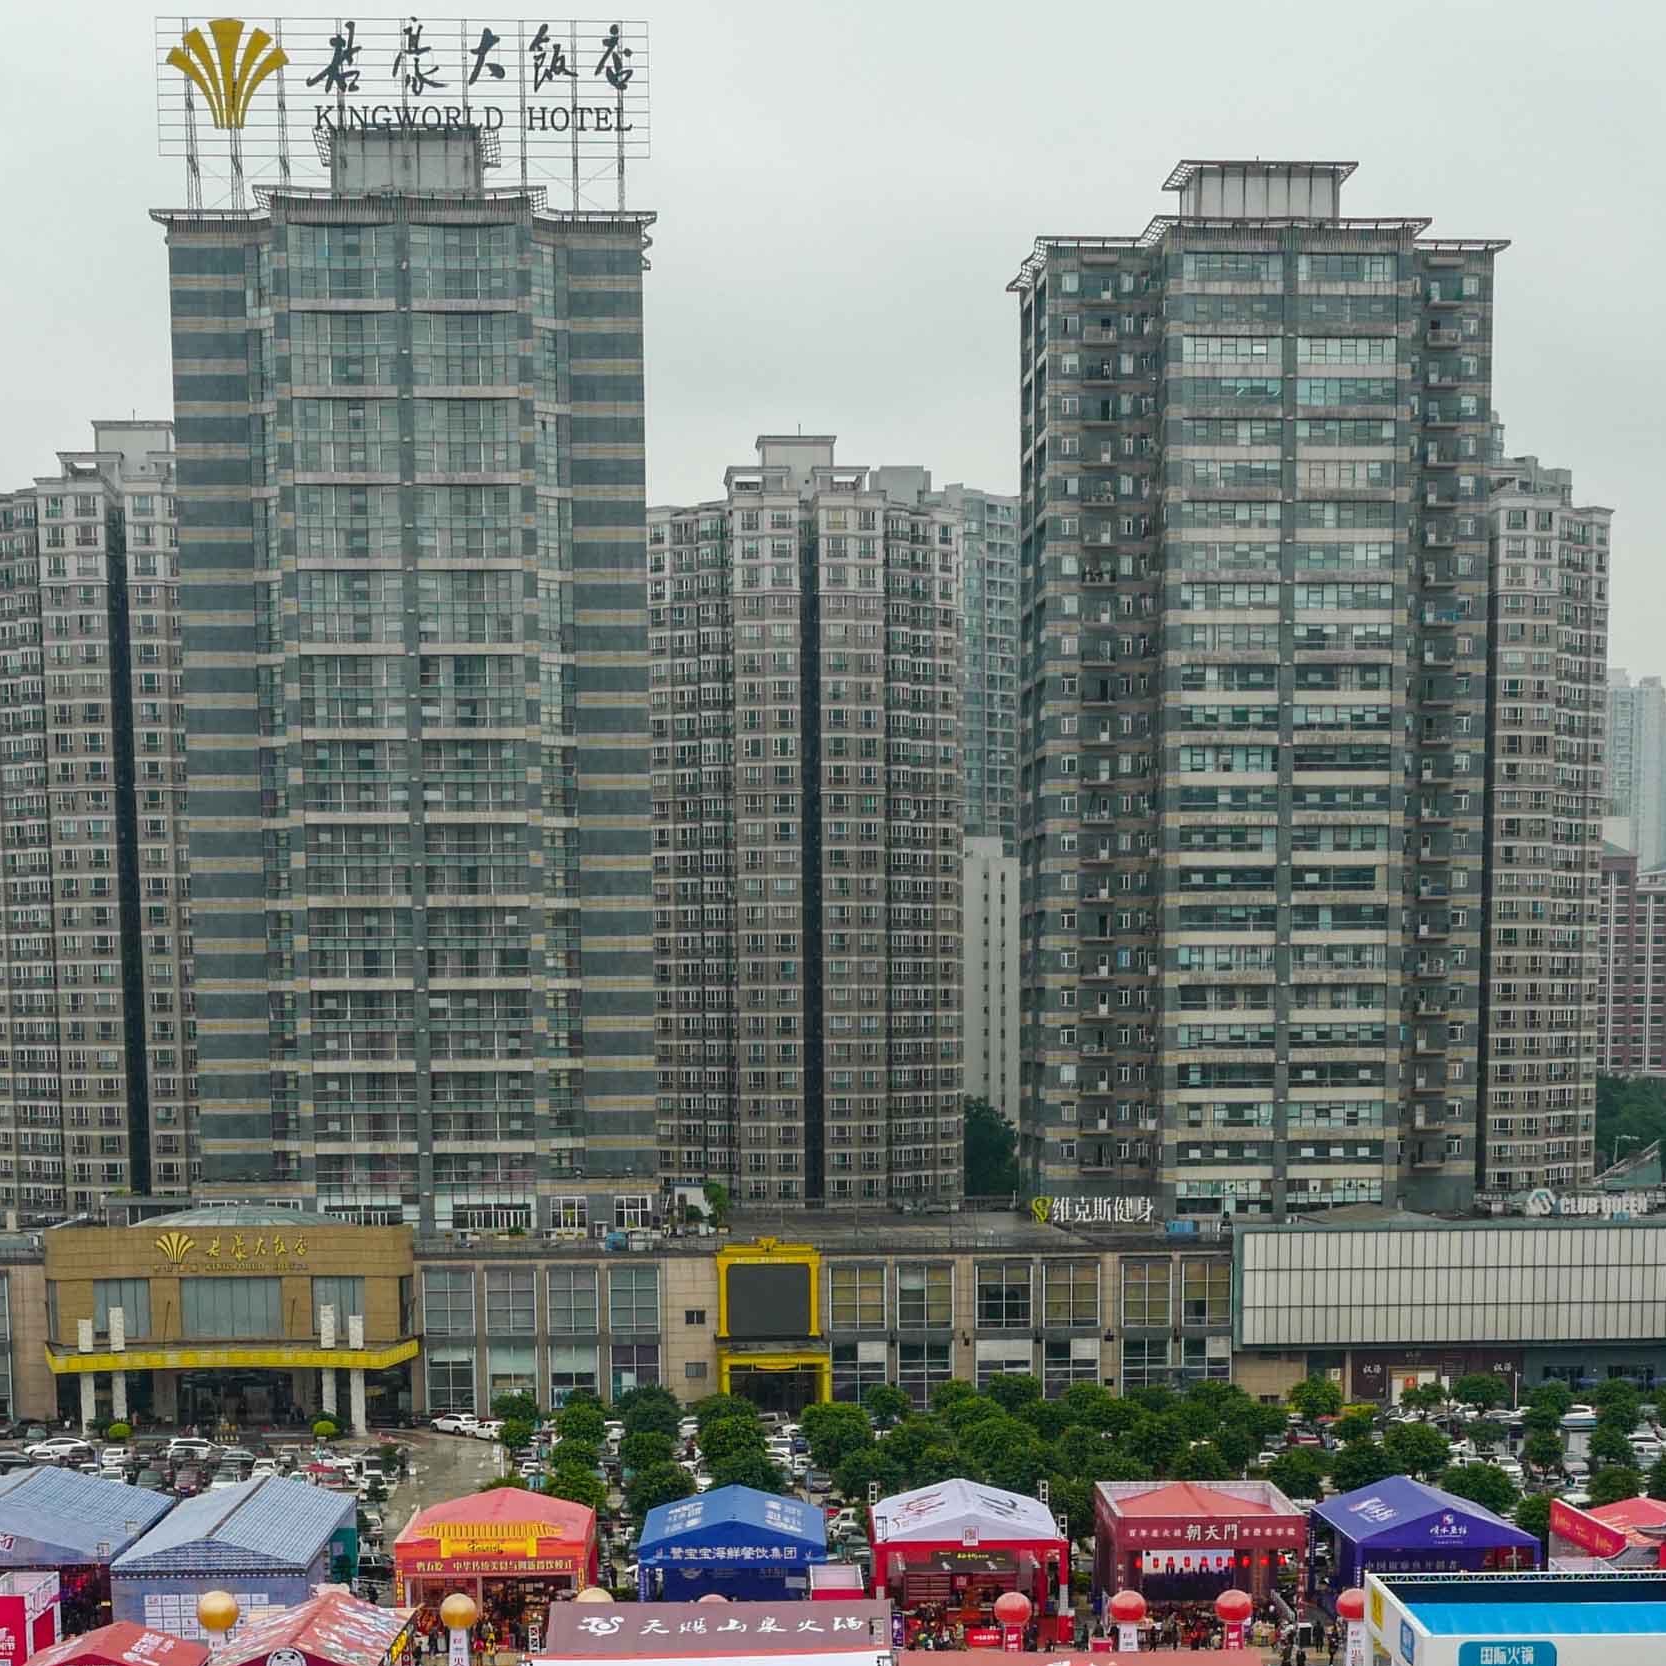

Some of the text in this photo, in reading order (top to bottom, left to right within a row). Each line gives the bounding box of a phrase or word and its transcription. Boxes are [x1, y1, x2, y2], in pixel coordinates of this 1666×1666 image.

[314, 104, 634, 132] KINGWORLD HOTEL
[1052, 1196, 1154, 1222] 维克斯健身
[1559, 1198, 1596, 1216] CLUB
[1480, 1646, 1534, 1665] 国际火锅
